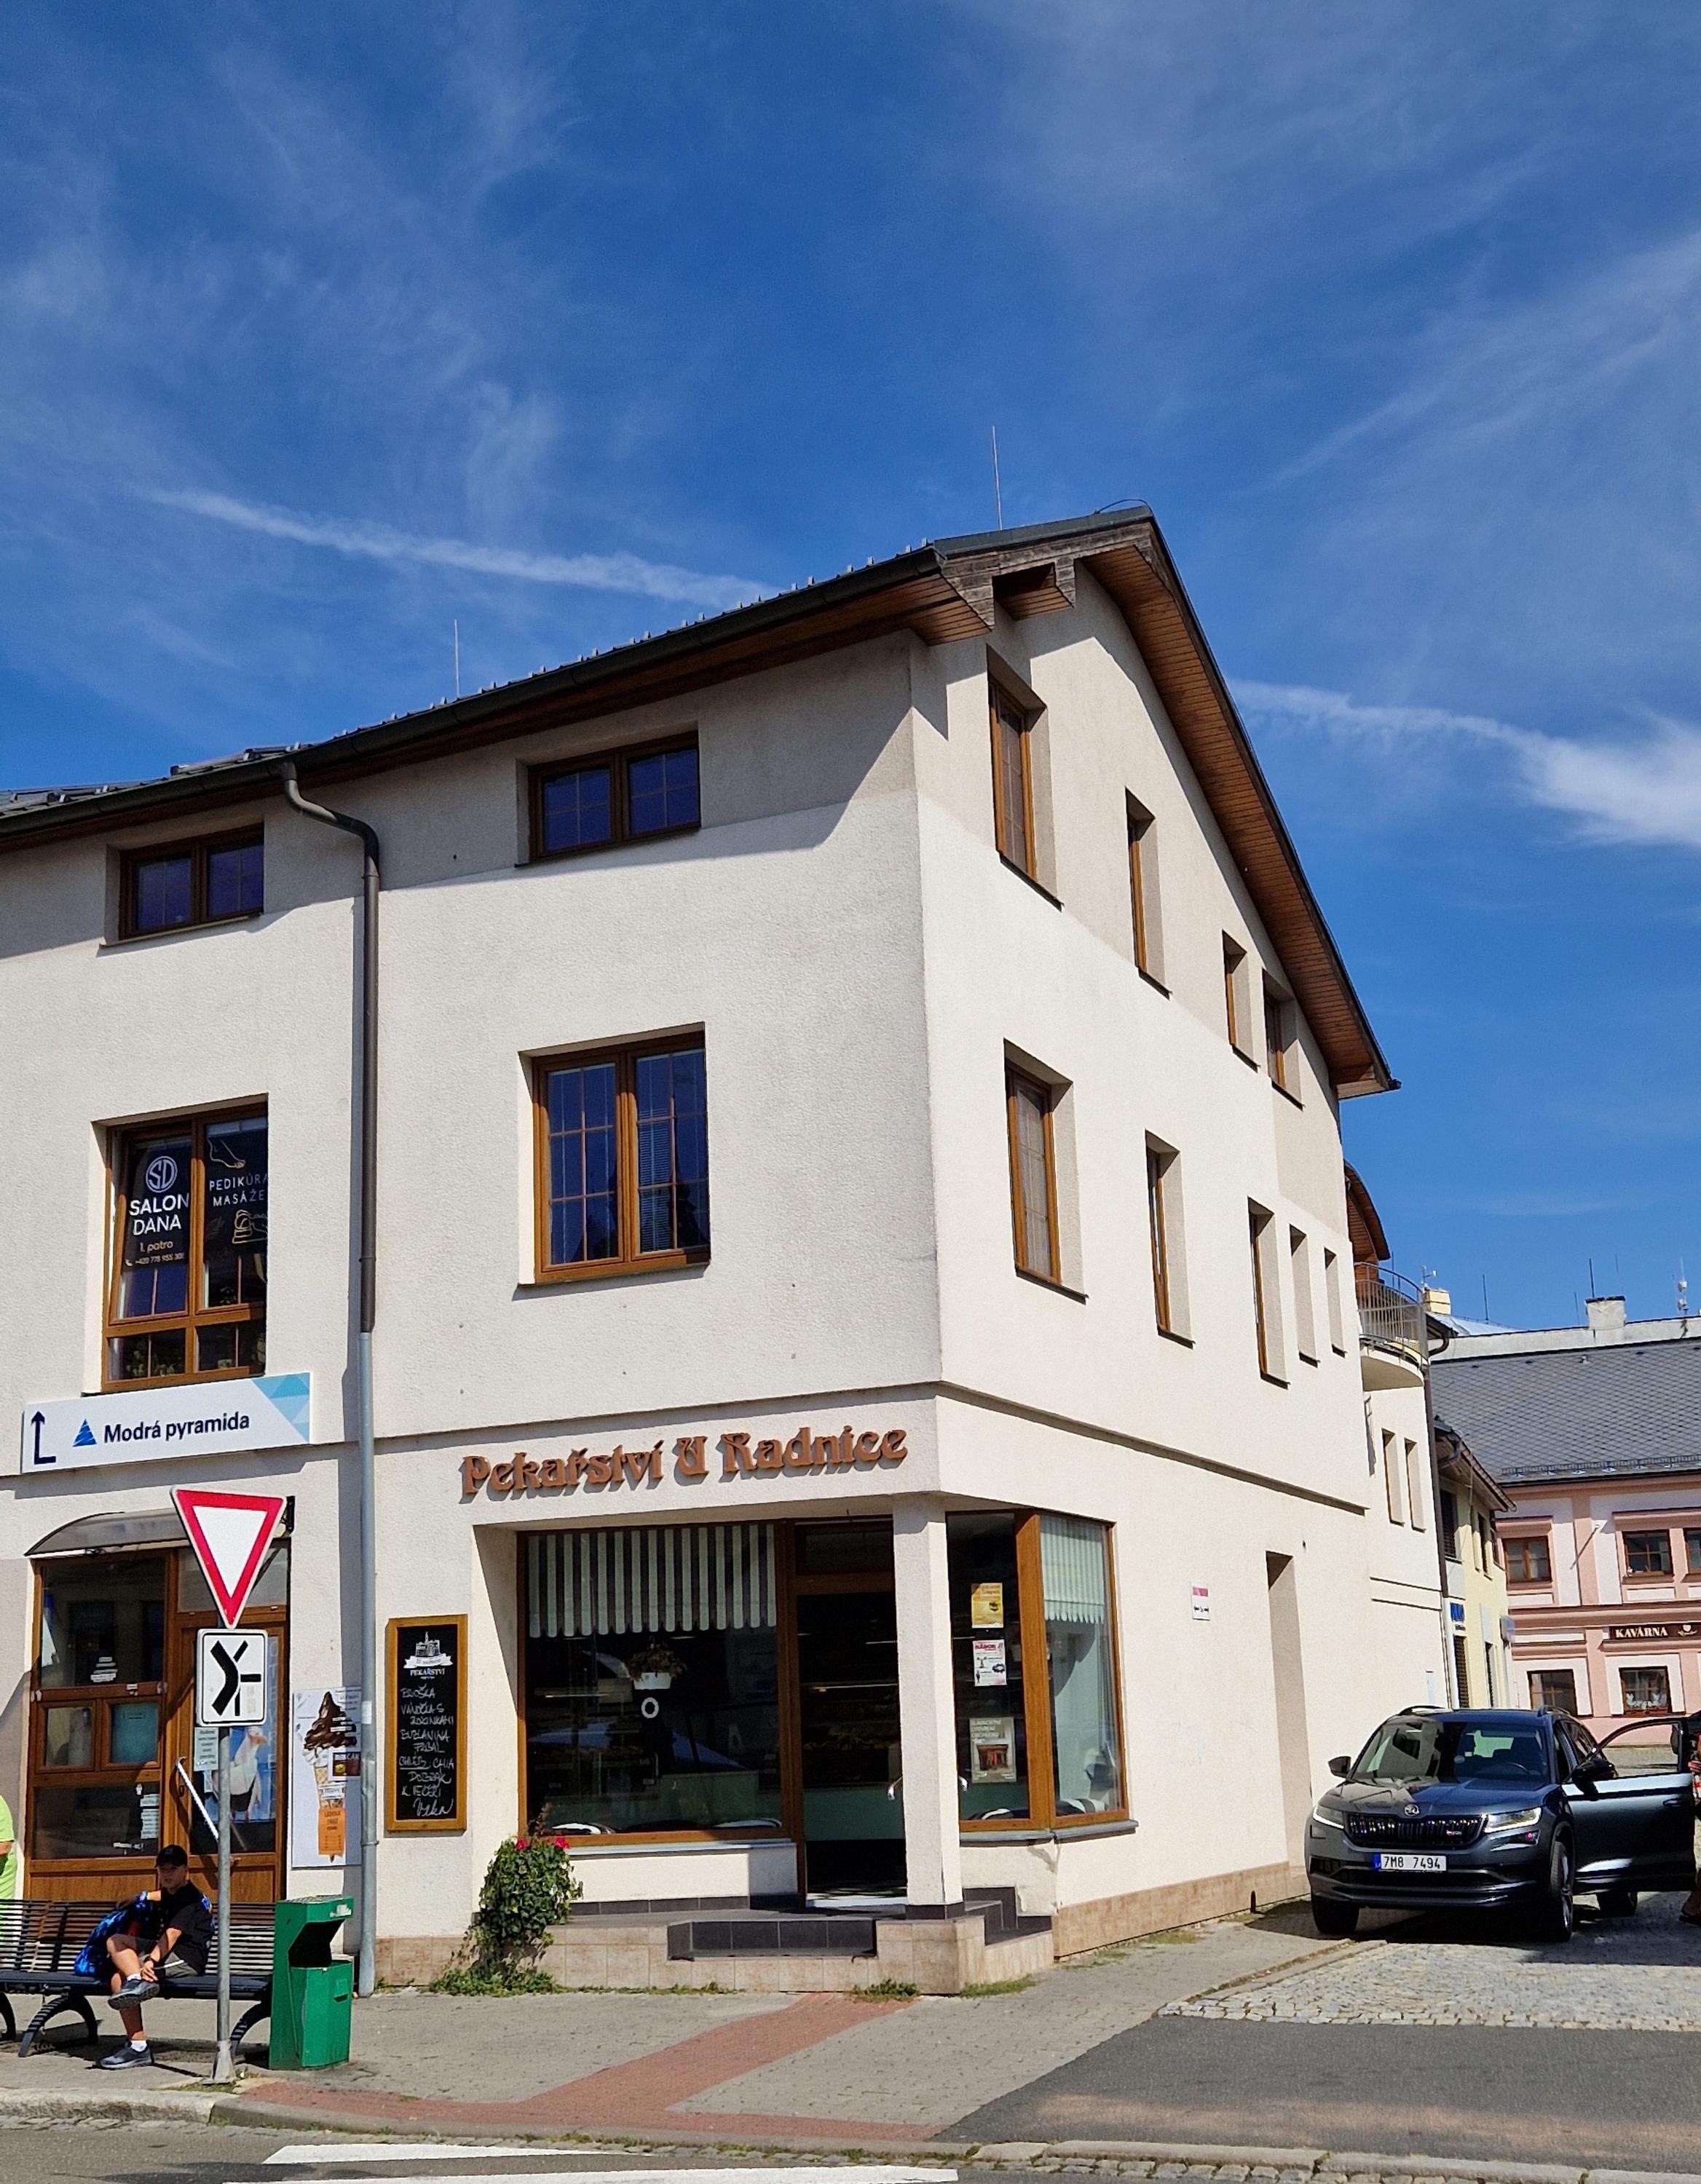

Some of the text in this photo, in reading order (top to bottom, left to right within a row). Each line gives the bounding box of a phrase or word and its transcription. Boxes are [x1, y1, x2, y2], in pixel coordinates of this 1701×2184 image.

[129, 1193, 189, 1216] SALON
[213, 1189, 264, 1207] MASÁŽE
[133, 1214, 181, 1236] DANA
[103, 1412, 250, 1444] Modrá pyramida
[462, 1425, 909, 1495] Pekařství U Radnice
[1614, 1626, 1668, 1638] KAVÁRNA
[1384, 1856, 1440, 1869] 7M8 7494
